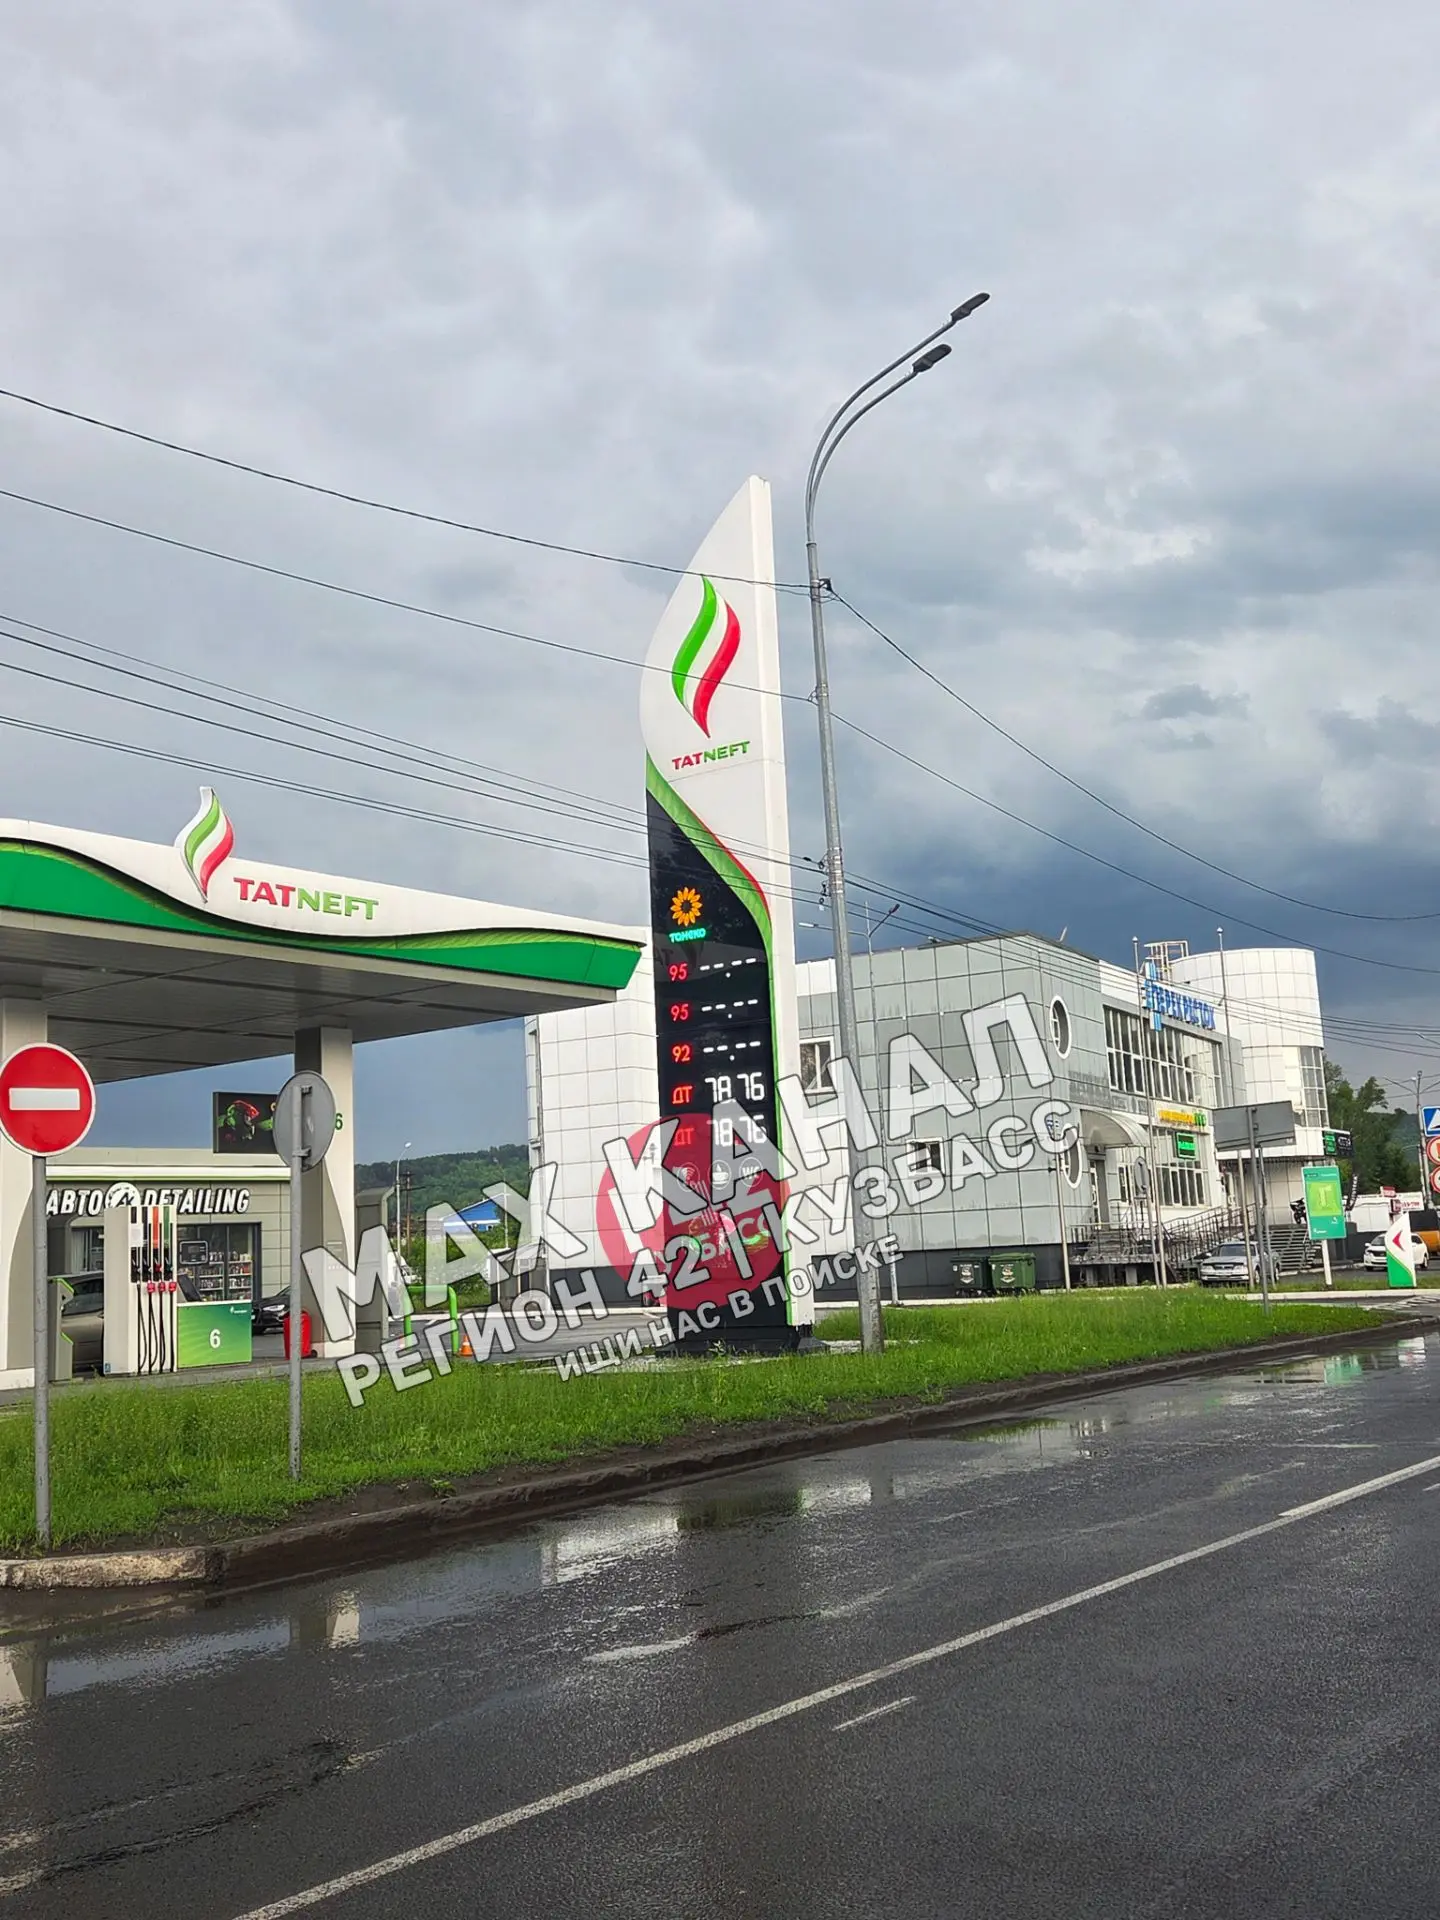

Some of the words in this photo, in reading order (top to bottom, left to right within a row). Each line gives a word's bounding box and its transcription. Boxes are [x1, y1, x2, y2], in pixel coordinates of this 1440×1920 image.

[671, 741, 750, 770] TATNEFT
[234, 877, 379, 920] TATNEFT
[669, 963, 688, 981] 95
[670, 1003, 689, 1021] 95
[671, 1044, 691, 1062] 92
[672, 1085, 693, 1105] ДТ
[209, 1328, 221, 1349] 6
